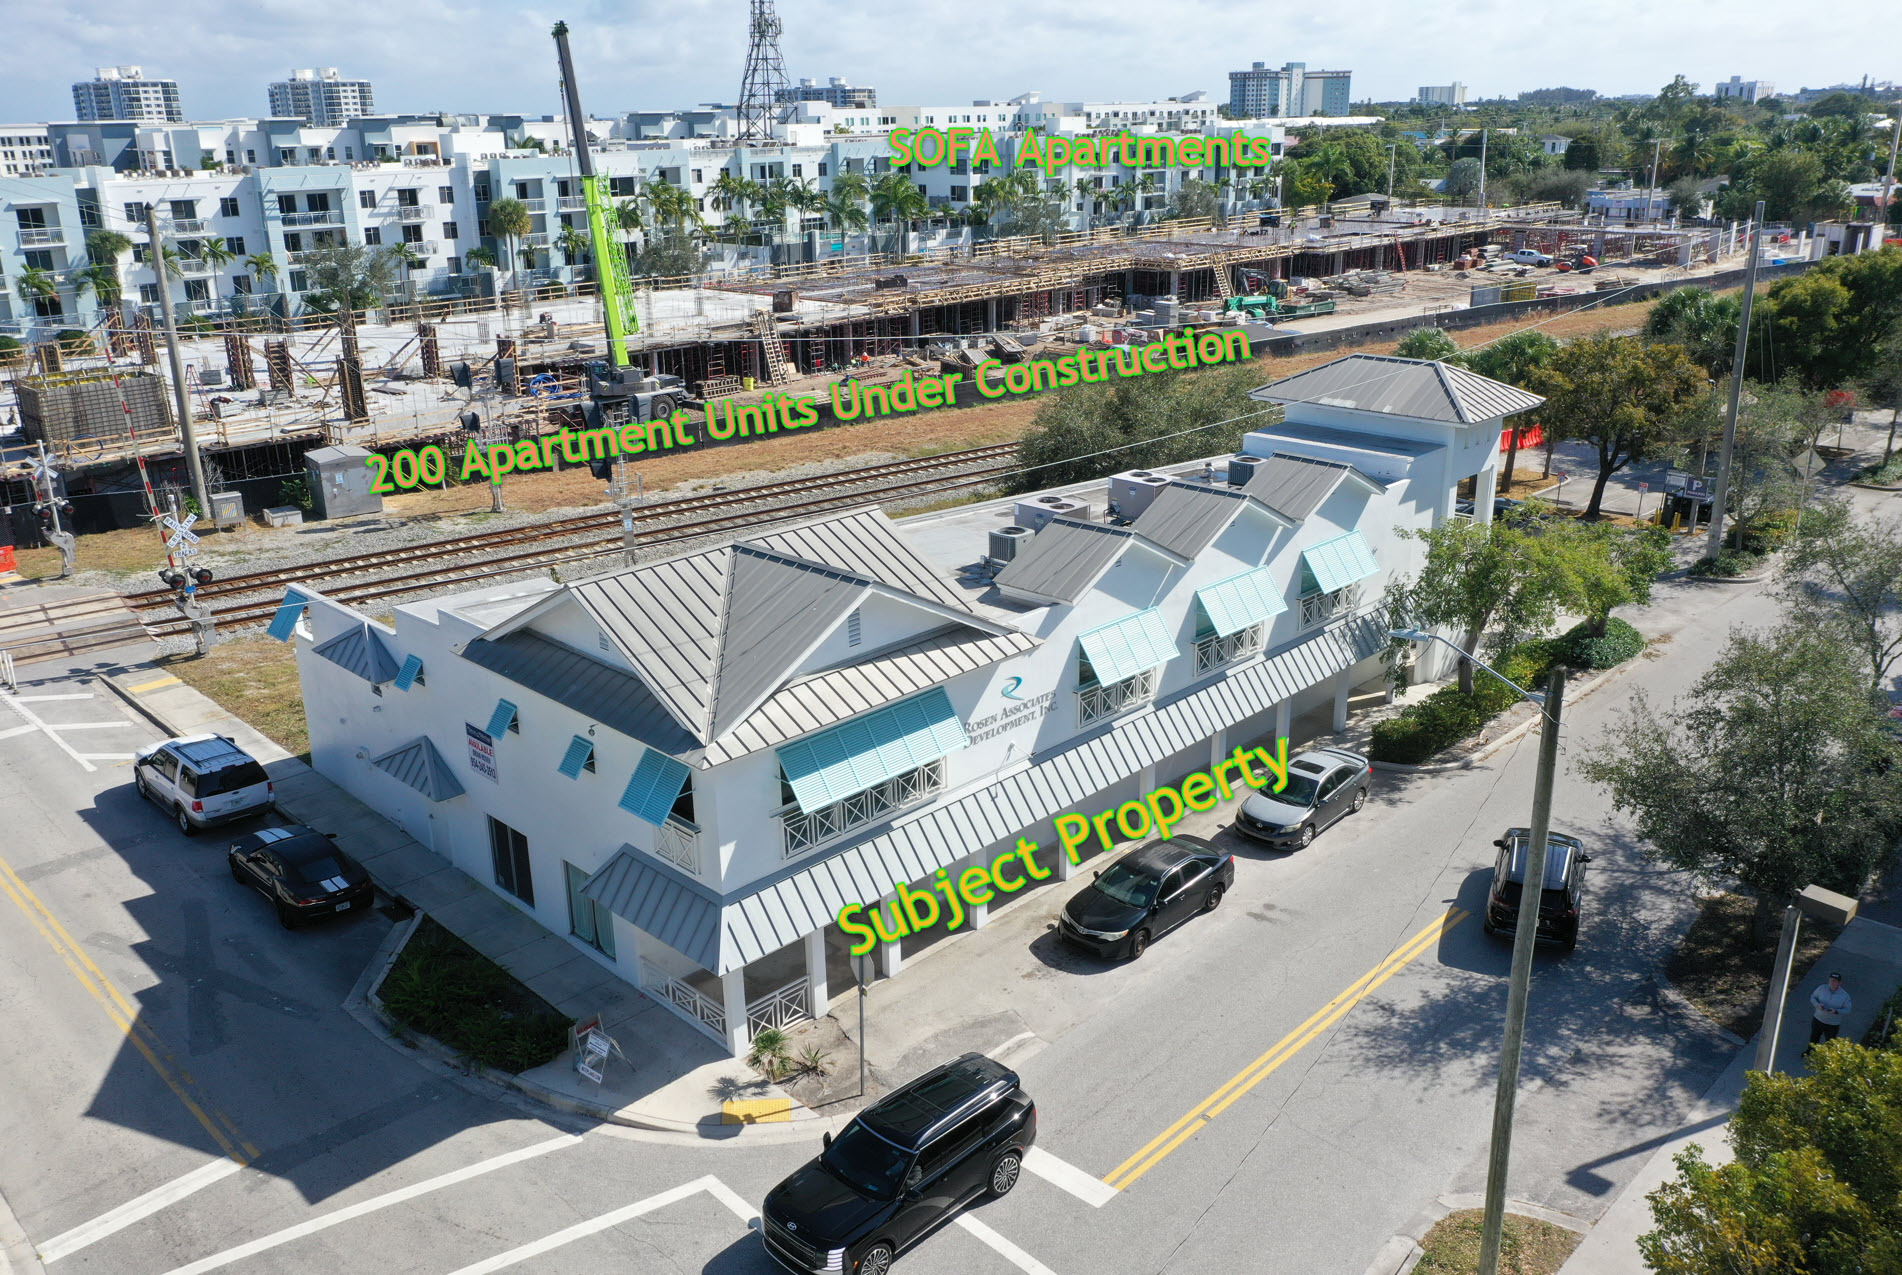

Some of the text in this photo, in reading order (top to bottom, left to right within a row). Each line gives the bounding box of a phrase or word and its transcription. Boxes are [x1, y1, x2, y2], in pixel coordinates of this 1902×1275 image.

[174, 548, 197, 557] TRACKS
[963, 689, 1057, 735] ROSEN ASSOCIATES
[1039, 701, 1059, 718] INC.
[469, 738, 493, 757] AVAILABLE
